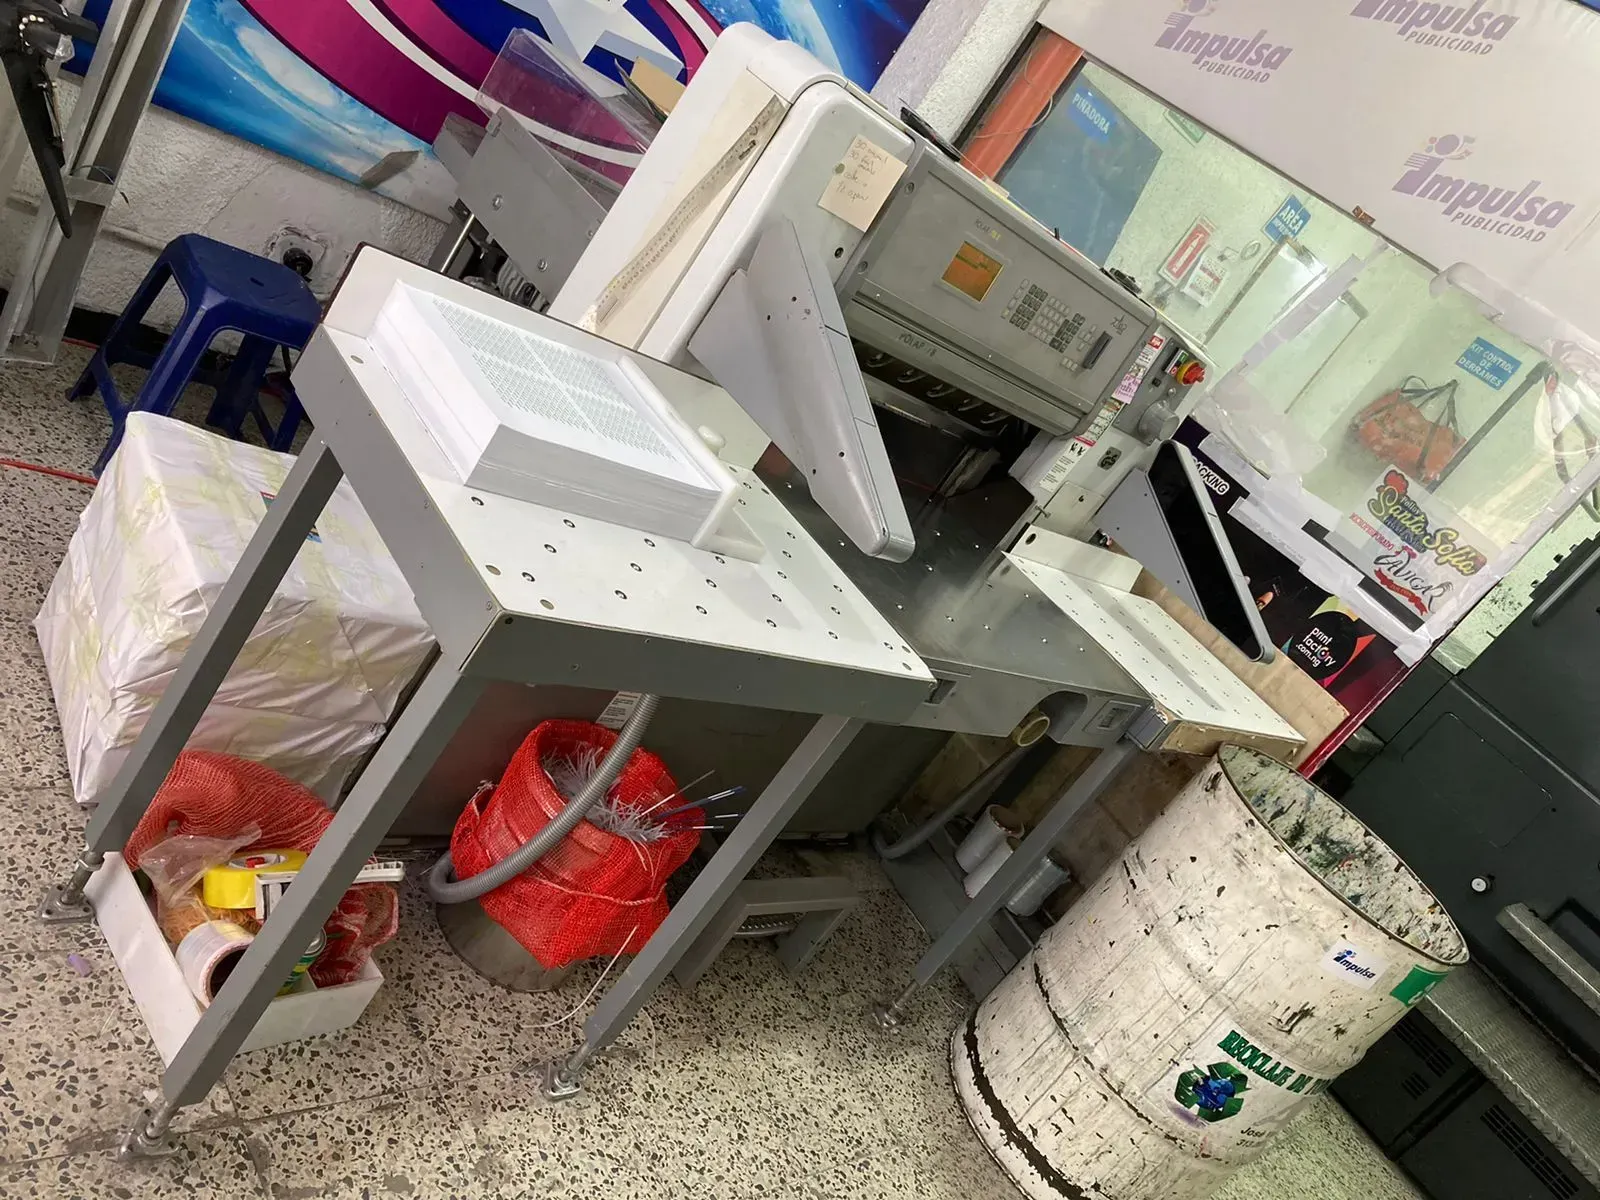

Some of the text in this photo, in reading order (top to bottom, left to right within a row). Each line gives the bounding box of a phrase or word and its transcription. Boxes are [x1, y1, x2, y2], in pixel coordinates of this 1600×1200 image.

[1404, 31, 1494, 56] PUBLICIDAD
[1199, 60, 1270, 84] PUBLICIDAD
[1278, 205, 1304, 234] AREA
[1451, 211, 1547, 243] PUBLICIDAD
[1458, 356, 1503, 387] DERRAMES
[1479, 359, 1493, 370] DE
[1482, 351, 1515, 374] CONTROL
[1367, 485, 1426, 536] Santa
[1302, 634, 1337, 667] factory
[1308, 627, 1333, 646] print
[1217, 1029, 1296, 1087] RECICLAJE
